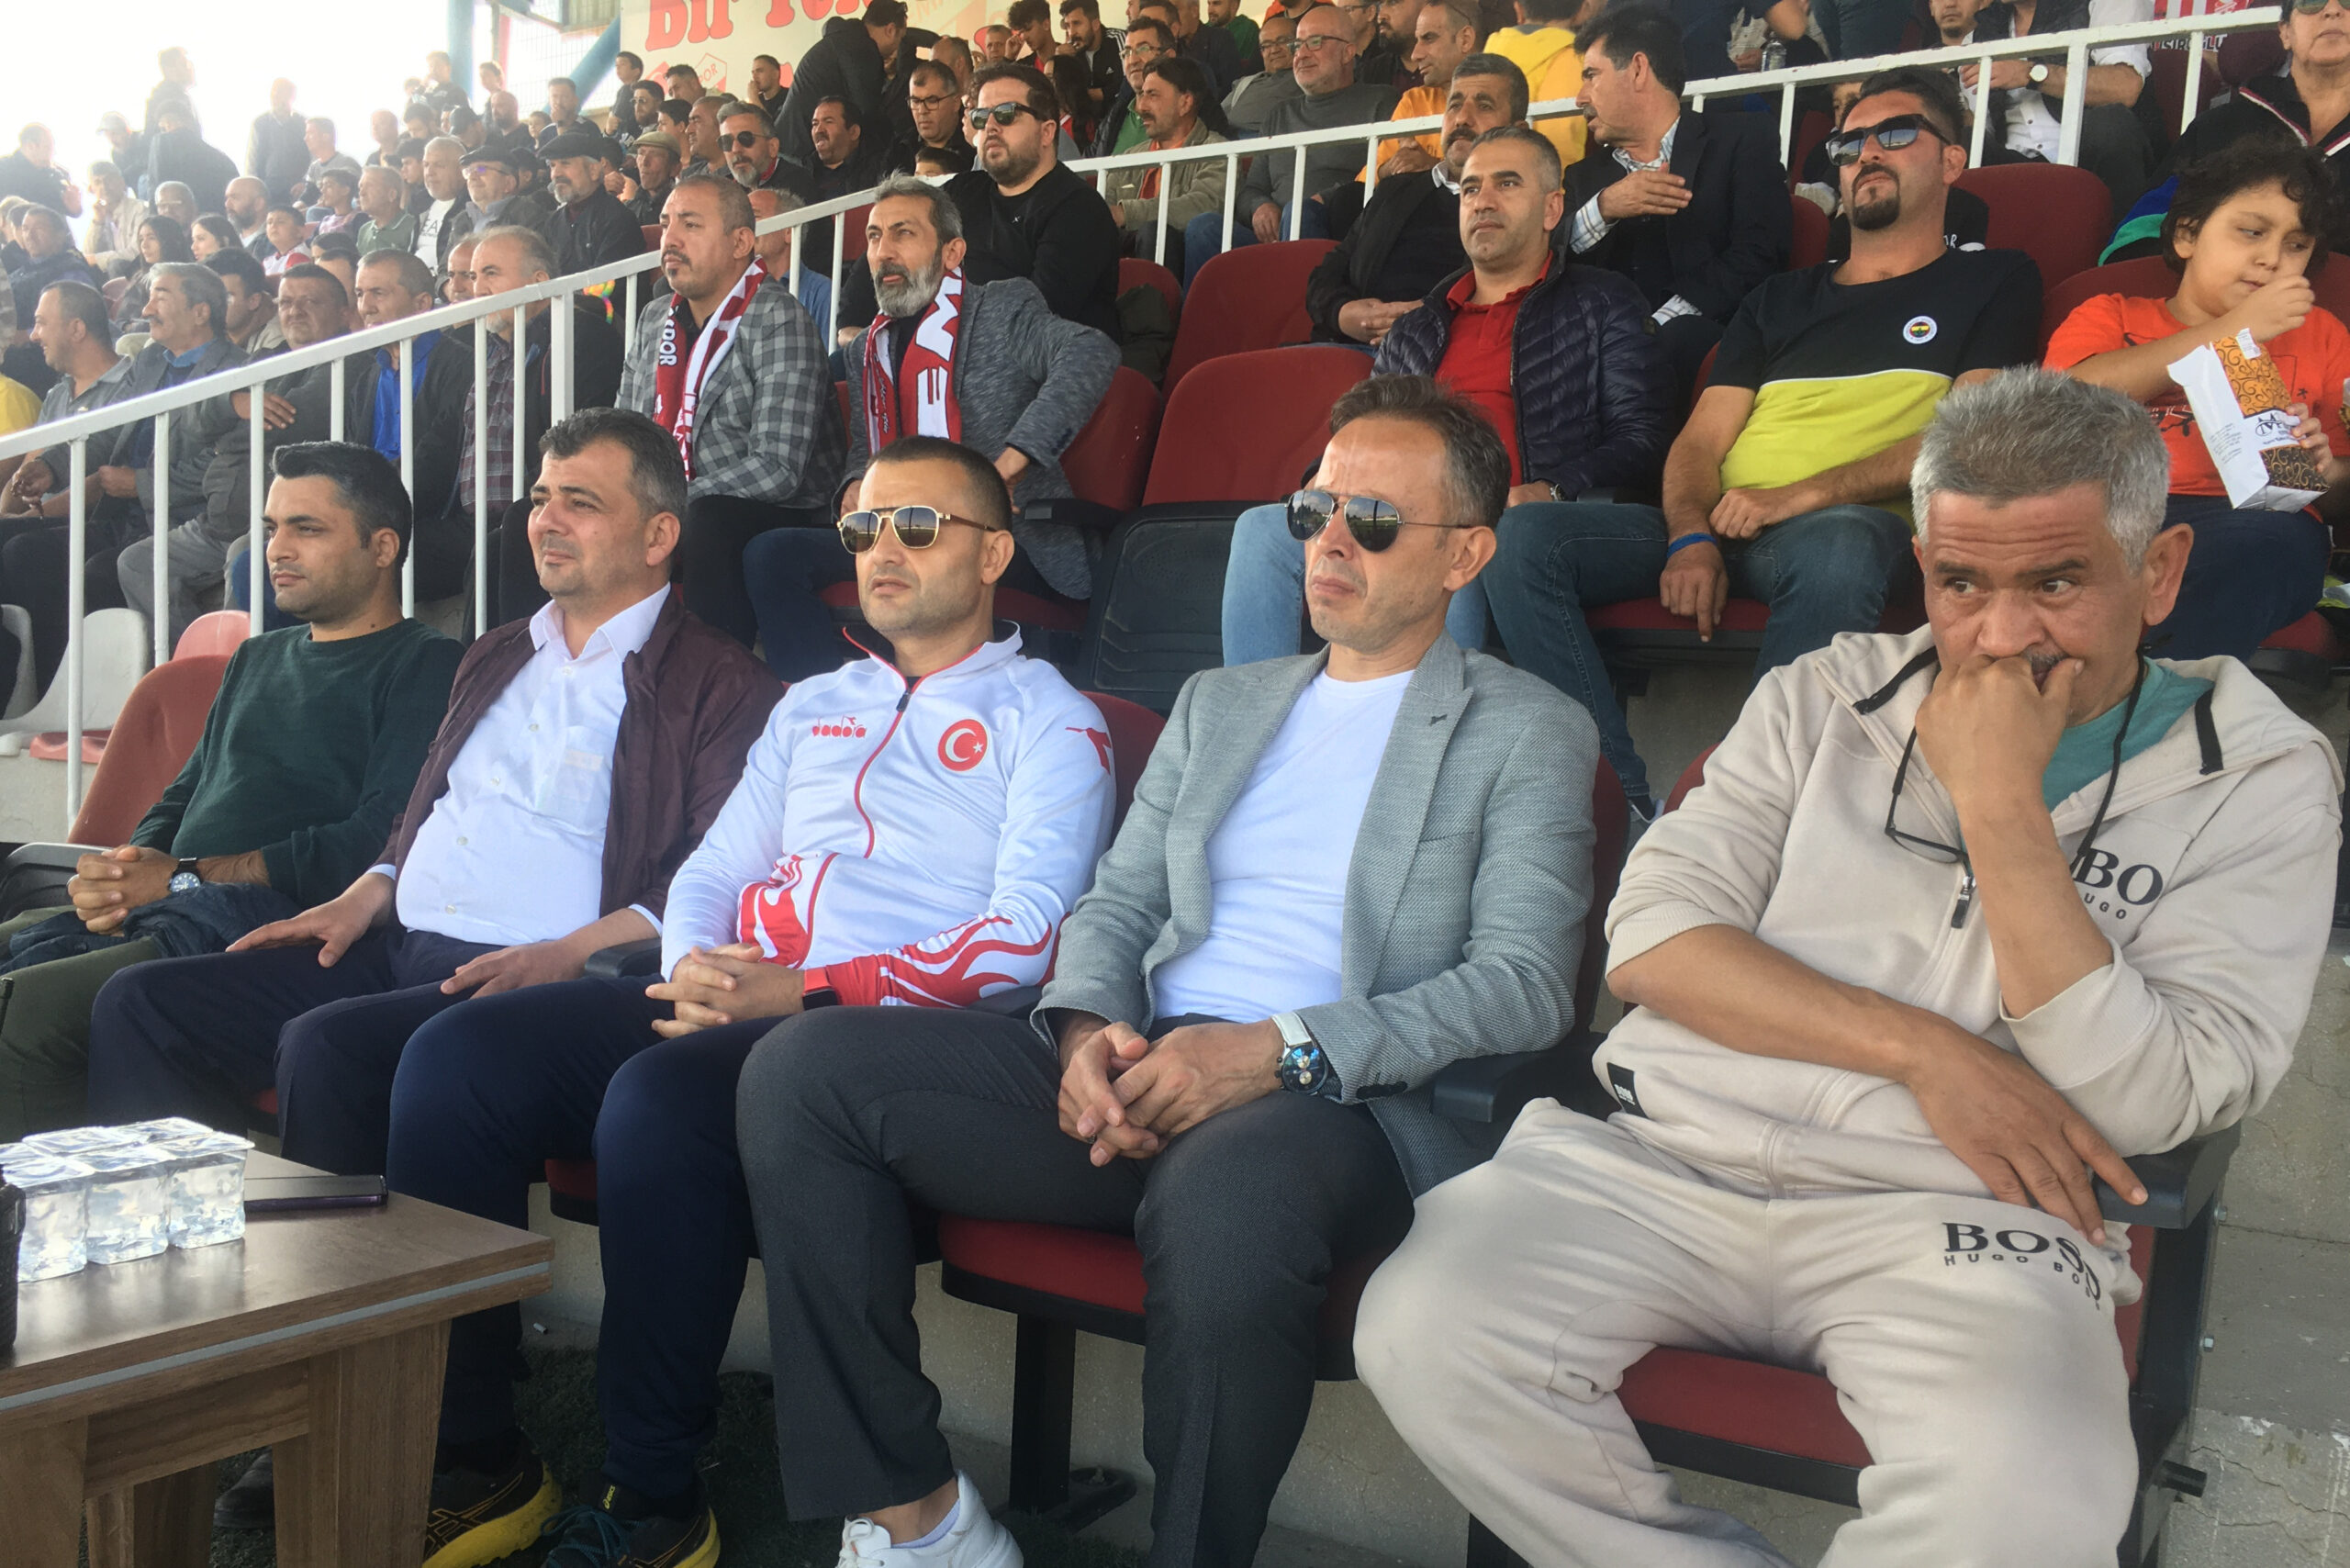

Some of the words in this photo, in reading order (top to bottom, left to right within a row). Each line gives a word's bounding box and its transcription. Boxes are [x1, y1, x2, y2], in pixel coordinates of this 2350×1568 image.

[2084, 892, 2127, 920] UGO
[1942, 1222, 2101, 1301] BOSS
[1944, 1254, 2029, 1267] HUGO
